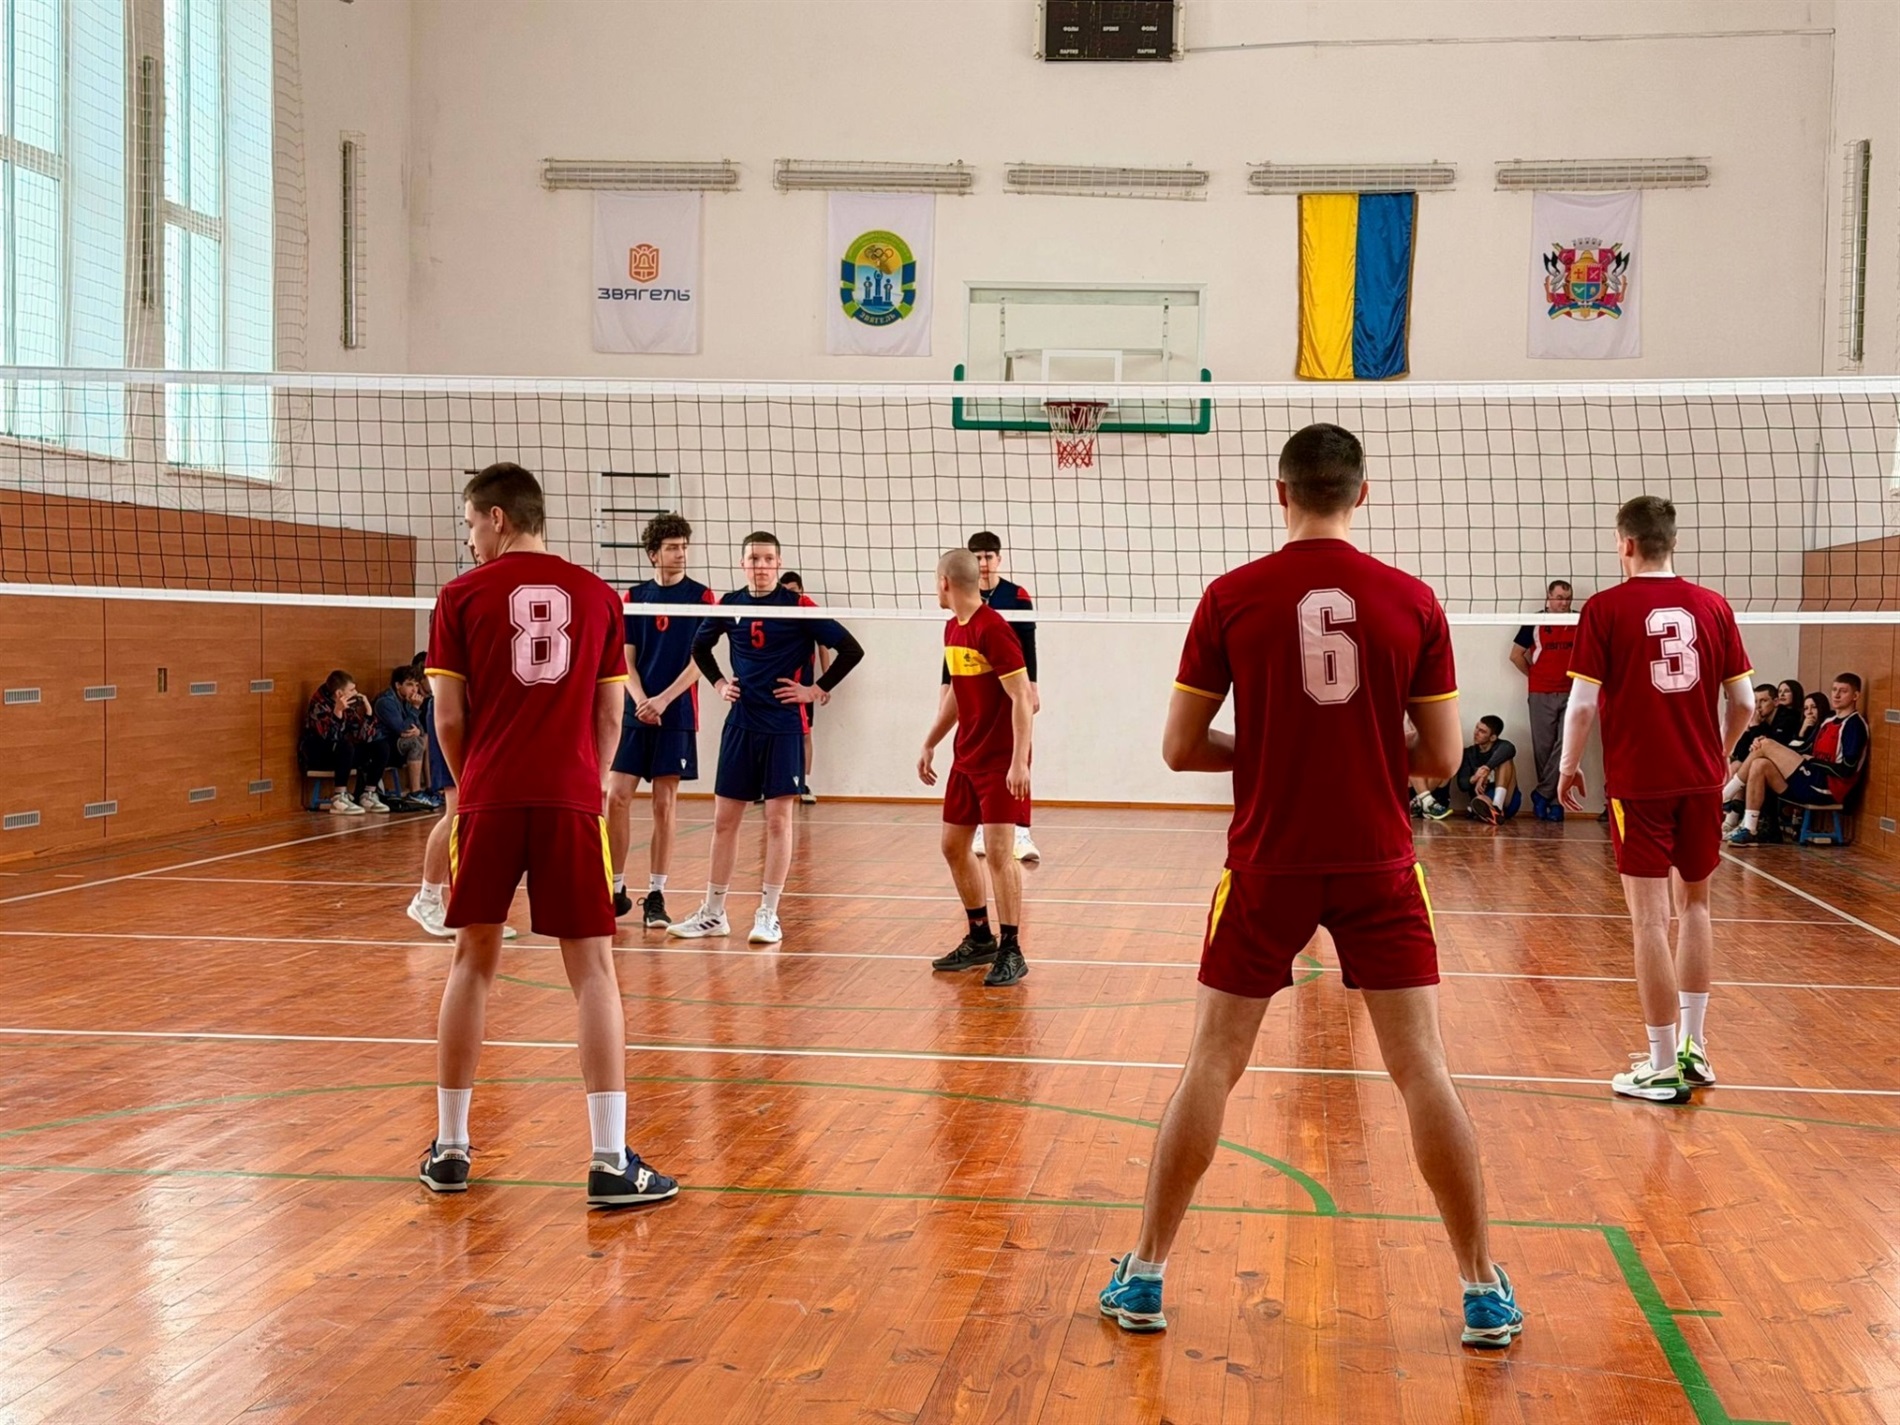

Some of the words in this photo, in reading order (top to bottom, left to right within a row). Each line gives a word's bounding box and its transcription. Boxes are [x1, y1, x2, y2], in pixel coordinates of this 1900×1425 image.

[508, 584, 572, 686] 8
[751, 620, 765, 648] 5
[1297, 587, 1359, 705] 6
[1644, 606, 1700, 694] 3
